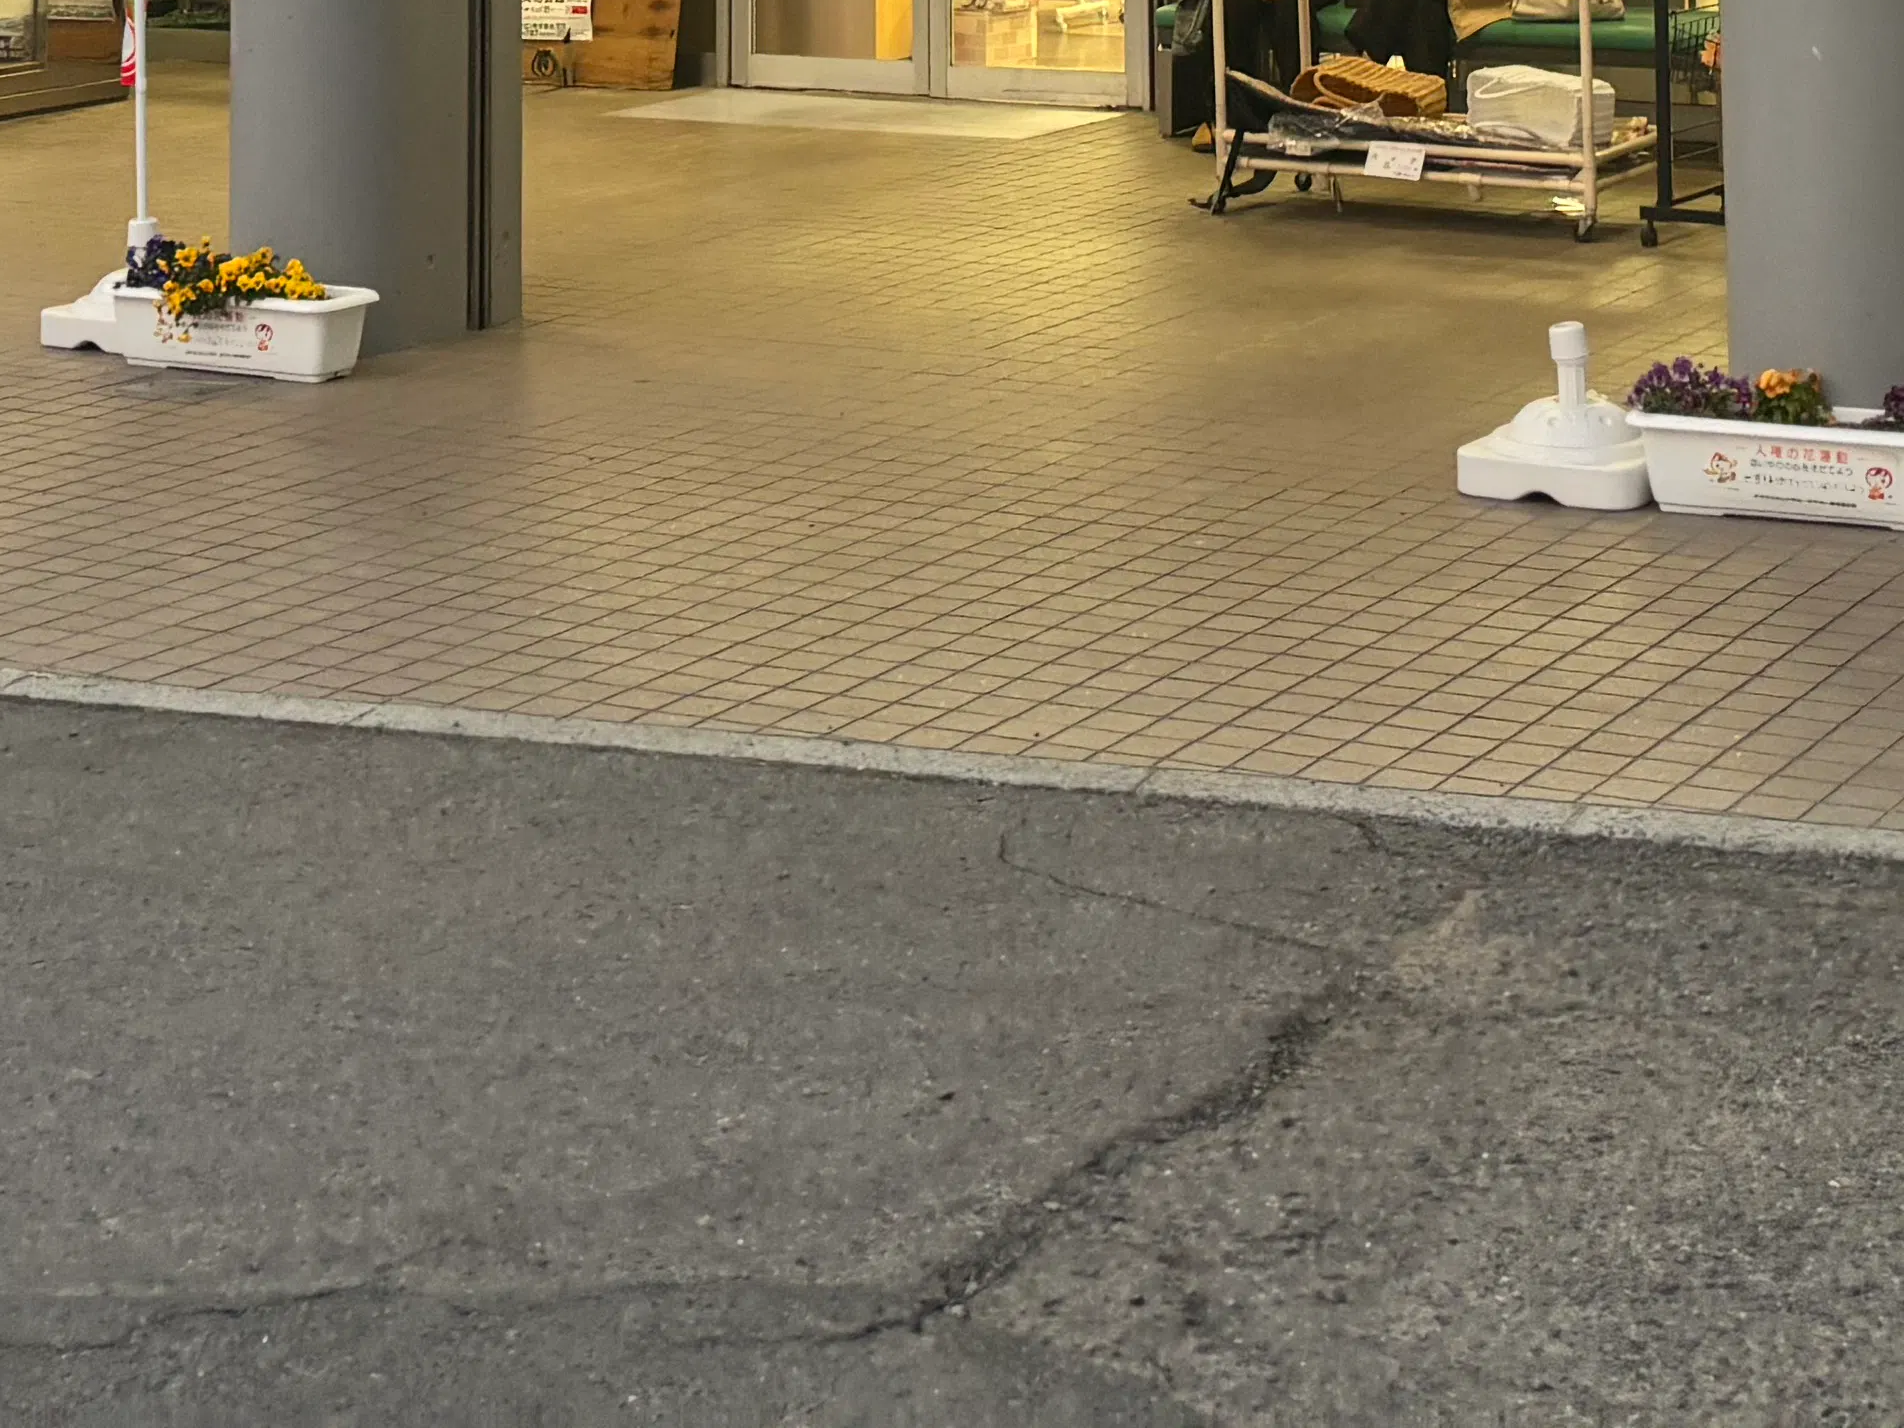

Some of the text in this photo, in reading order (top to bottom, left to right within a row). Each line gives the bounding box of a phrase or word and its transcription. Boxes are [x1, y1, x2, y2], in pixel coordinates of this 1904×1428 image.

[1756, 444, 1848, 464] 人権の花運動
